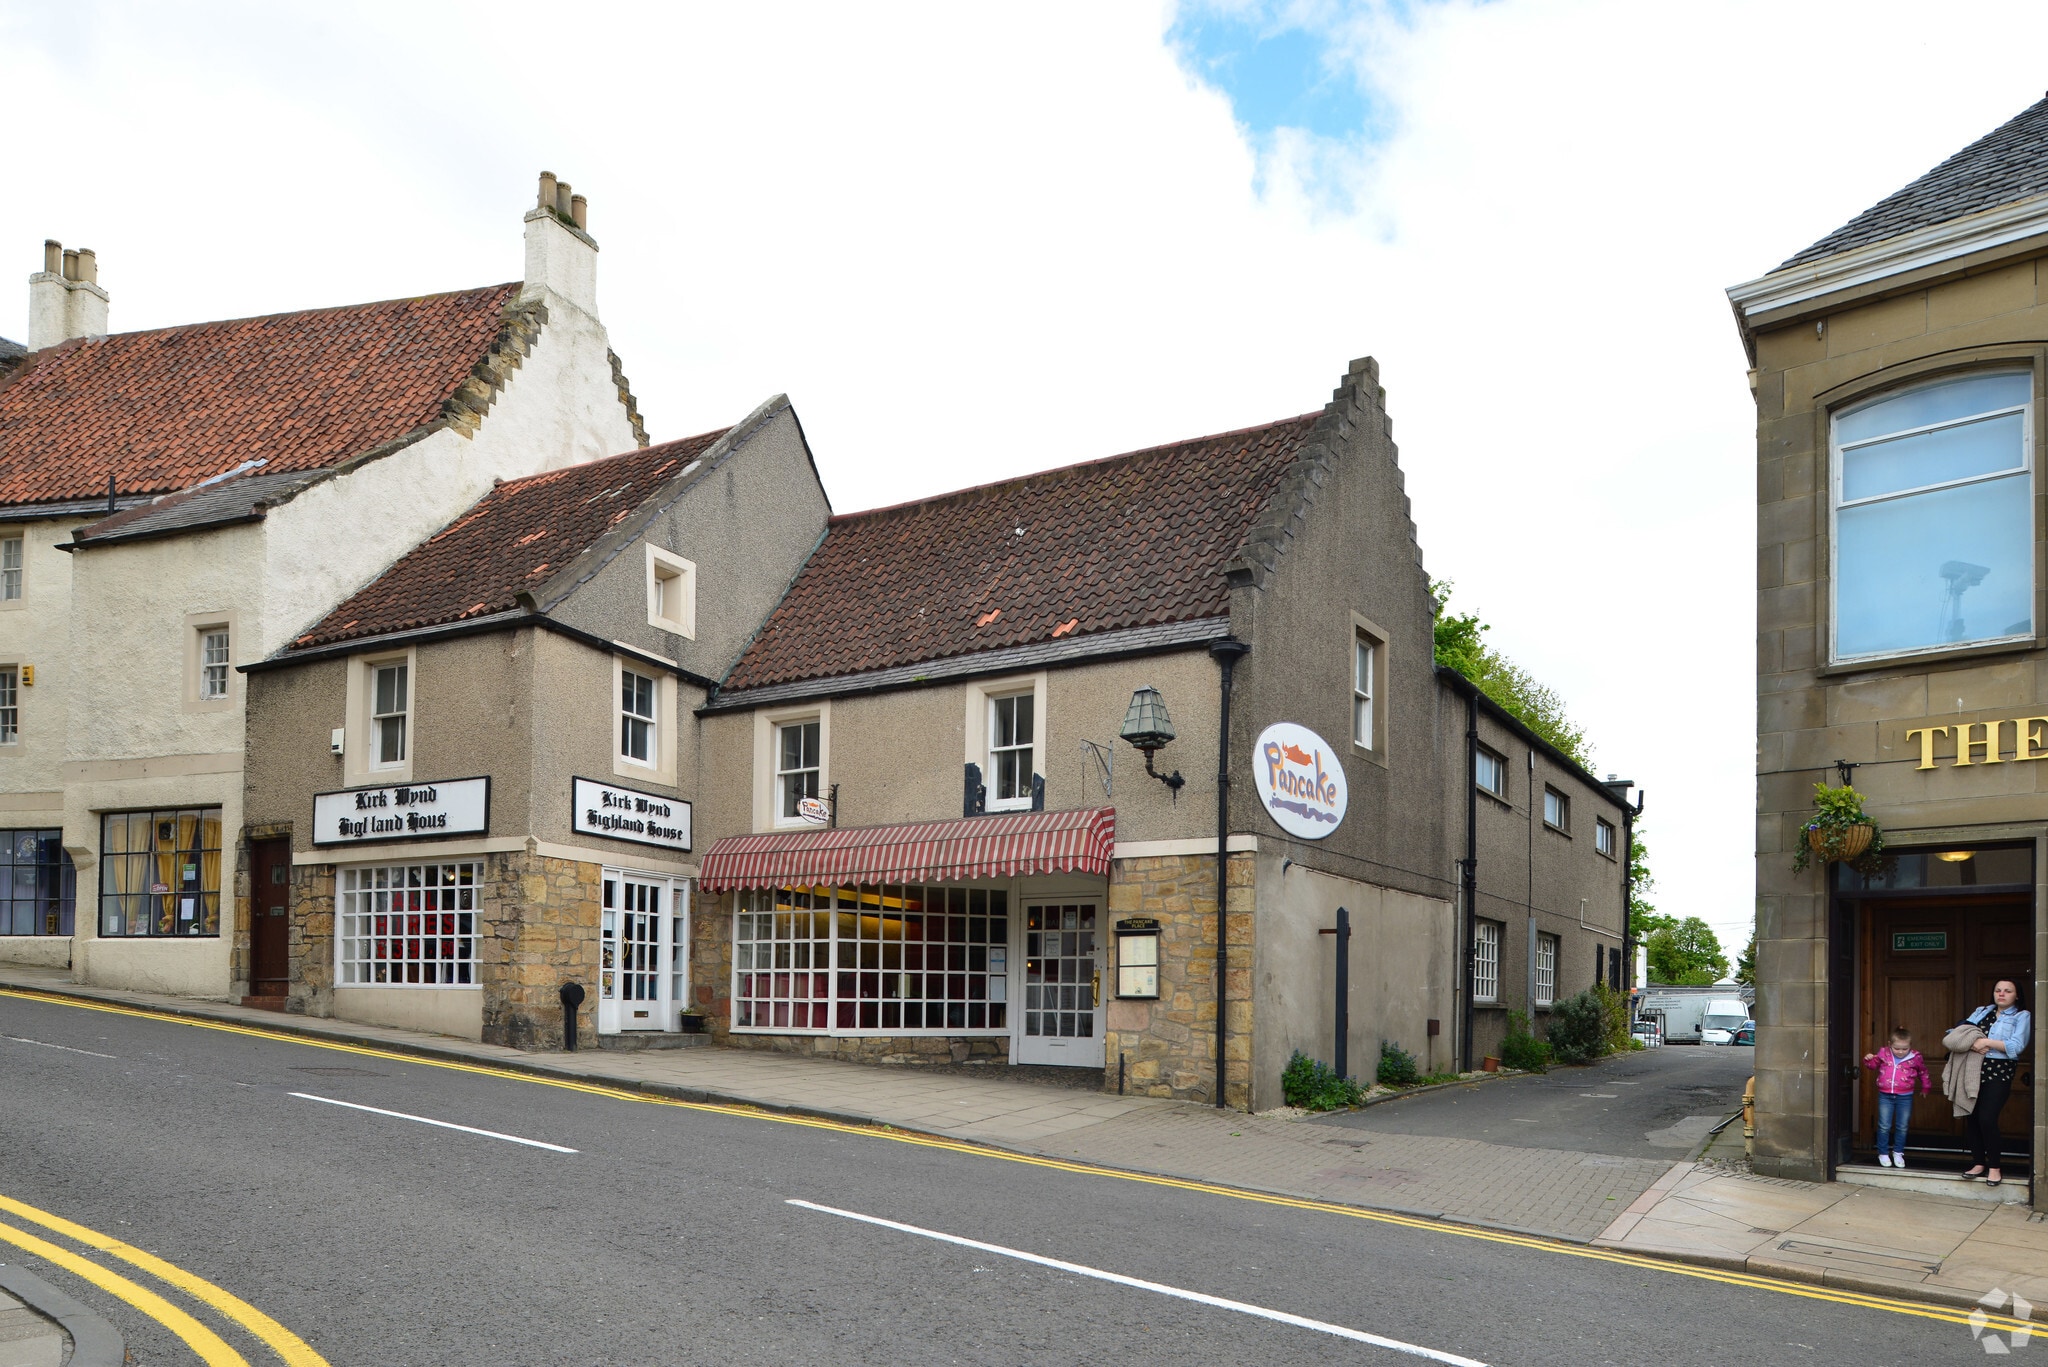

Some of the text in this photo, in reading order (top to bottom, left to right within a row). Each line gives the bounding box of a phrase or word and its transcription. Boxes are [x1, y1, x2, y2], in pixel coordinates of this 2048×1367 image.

[1906, 715, 2048, 770] THE
[1263, 741, 1337, 807] Pancake
[355, 786, 437, 810] Kirk Wynd
[602, 791, 671, 817] Kirk Wynd
[802, 801, 827, 817] Pancake
[587, 809, 683, 840] Highland House
[392, 891, 437, 911] ALL
[376, 914, 455, 935] HIRES
